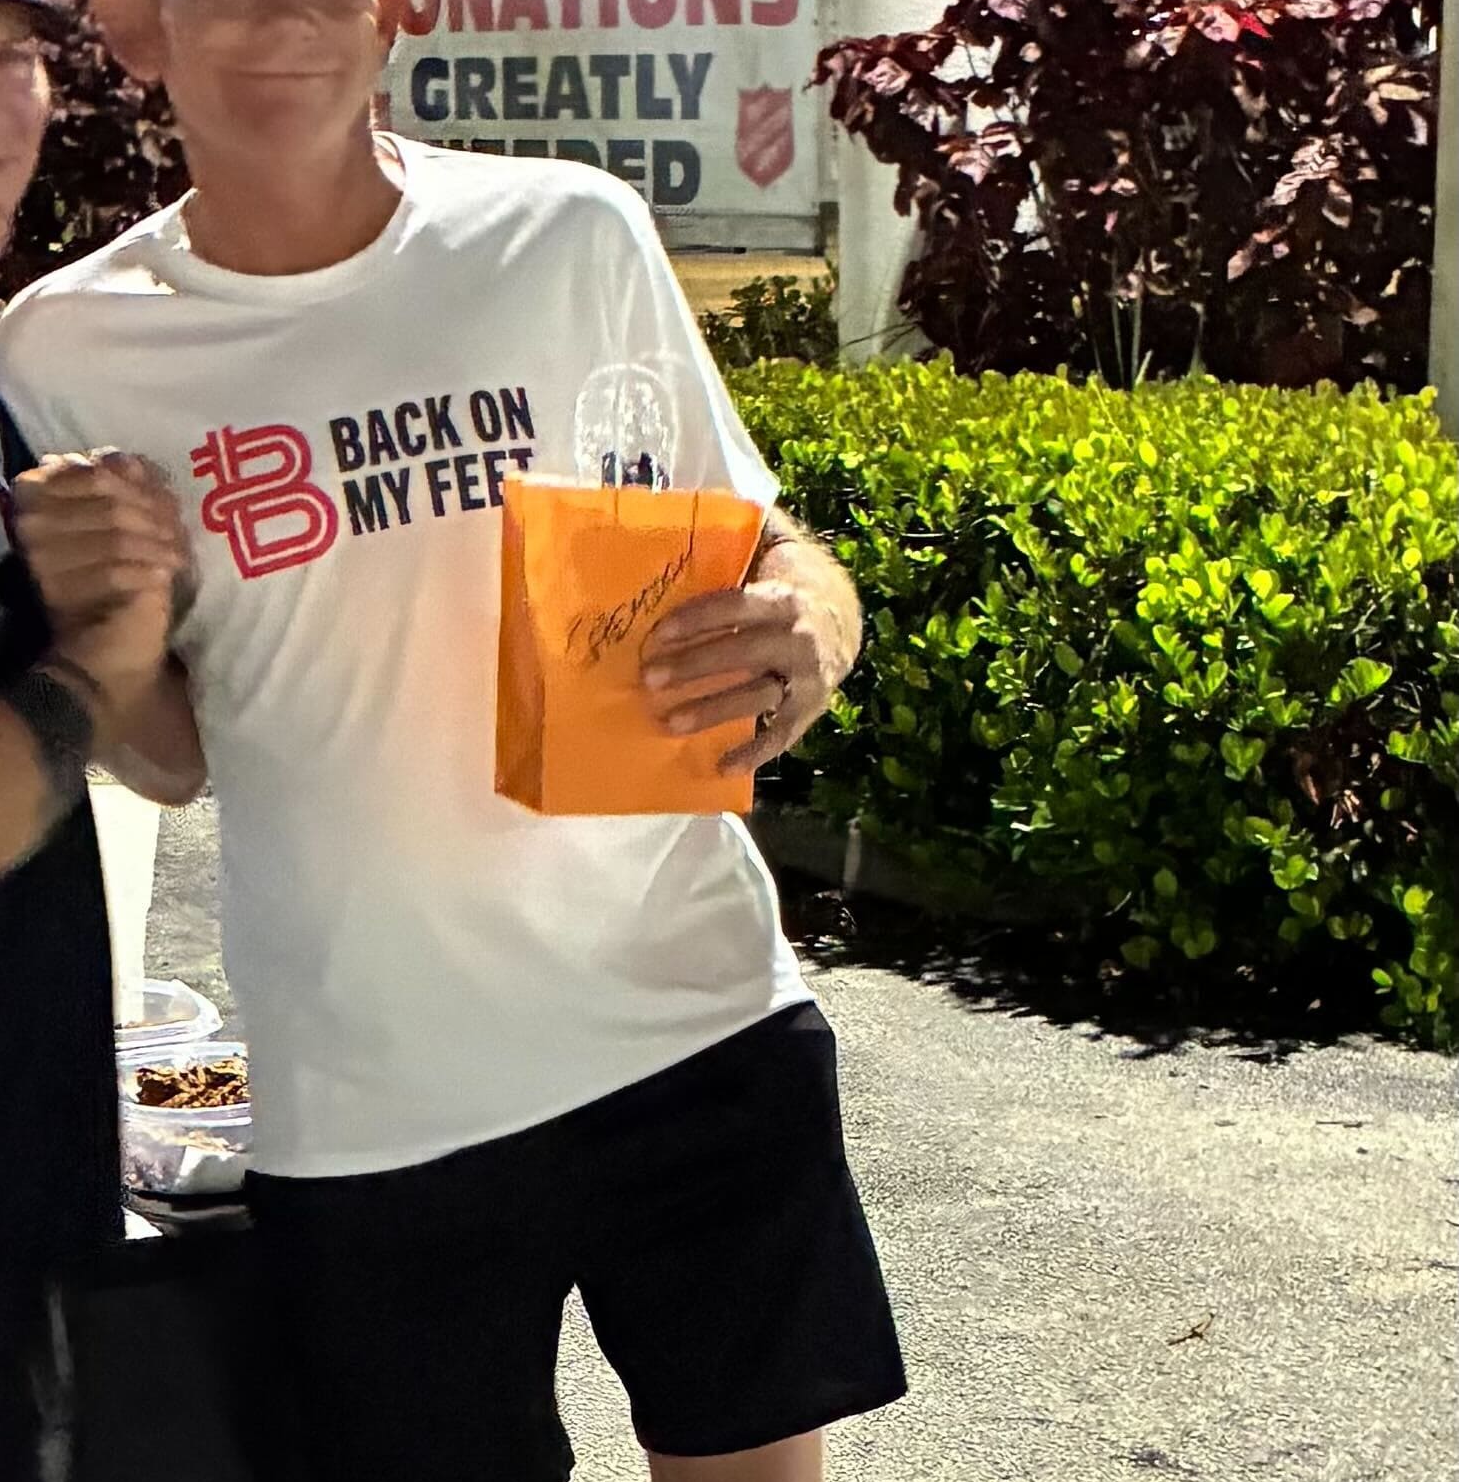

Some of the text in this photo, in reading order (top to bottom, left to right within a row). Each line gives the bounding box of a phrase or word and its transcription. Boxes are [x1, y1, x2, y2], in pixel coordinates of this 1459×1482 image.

[410, 53, 712, 121] GREATLY
[329, 386, 535, 471] BACK ON
[342, 472, 411, 536] MY
